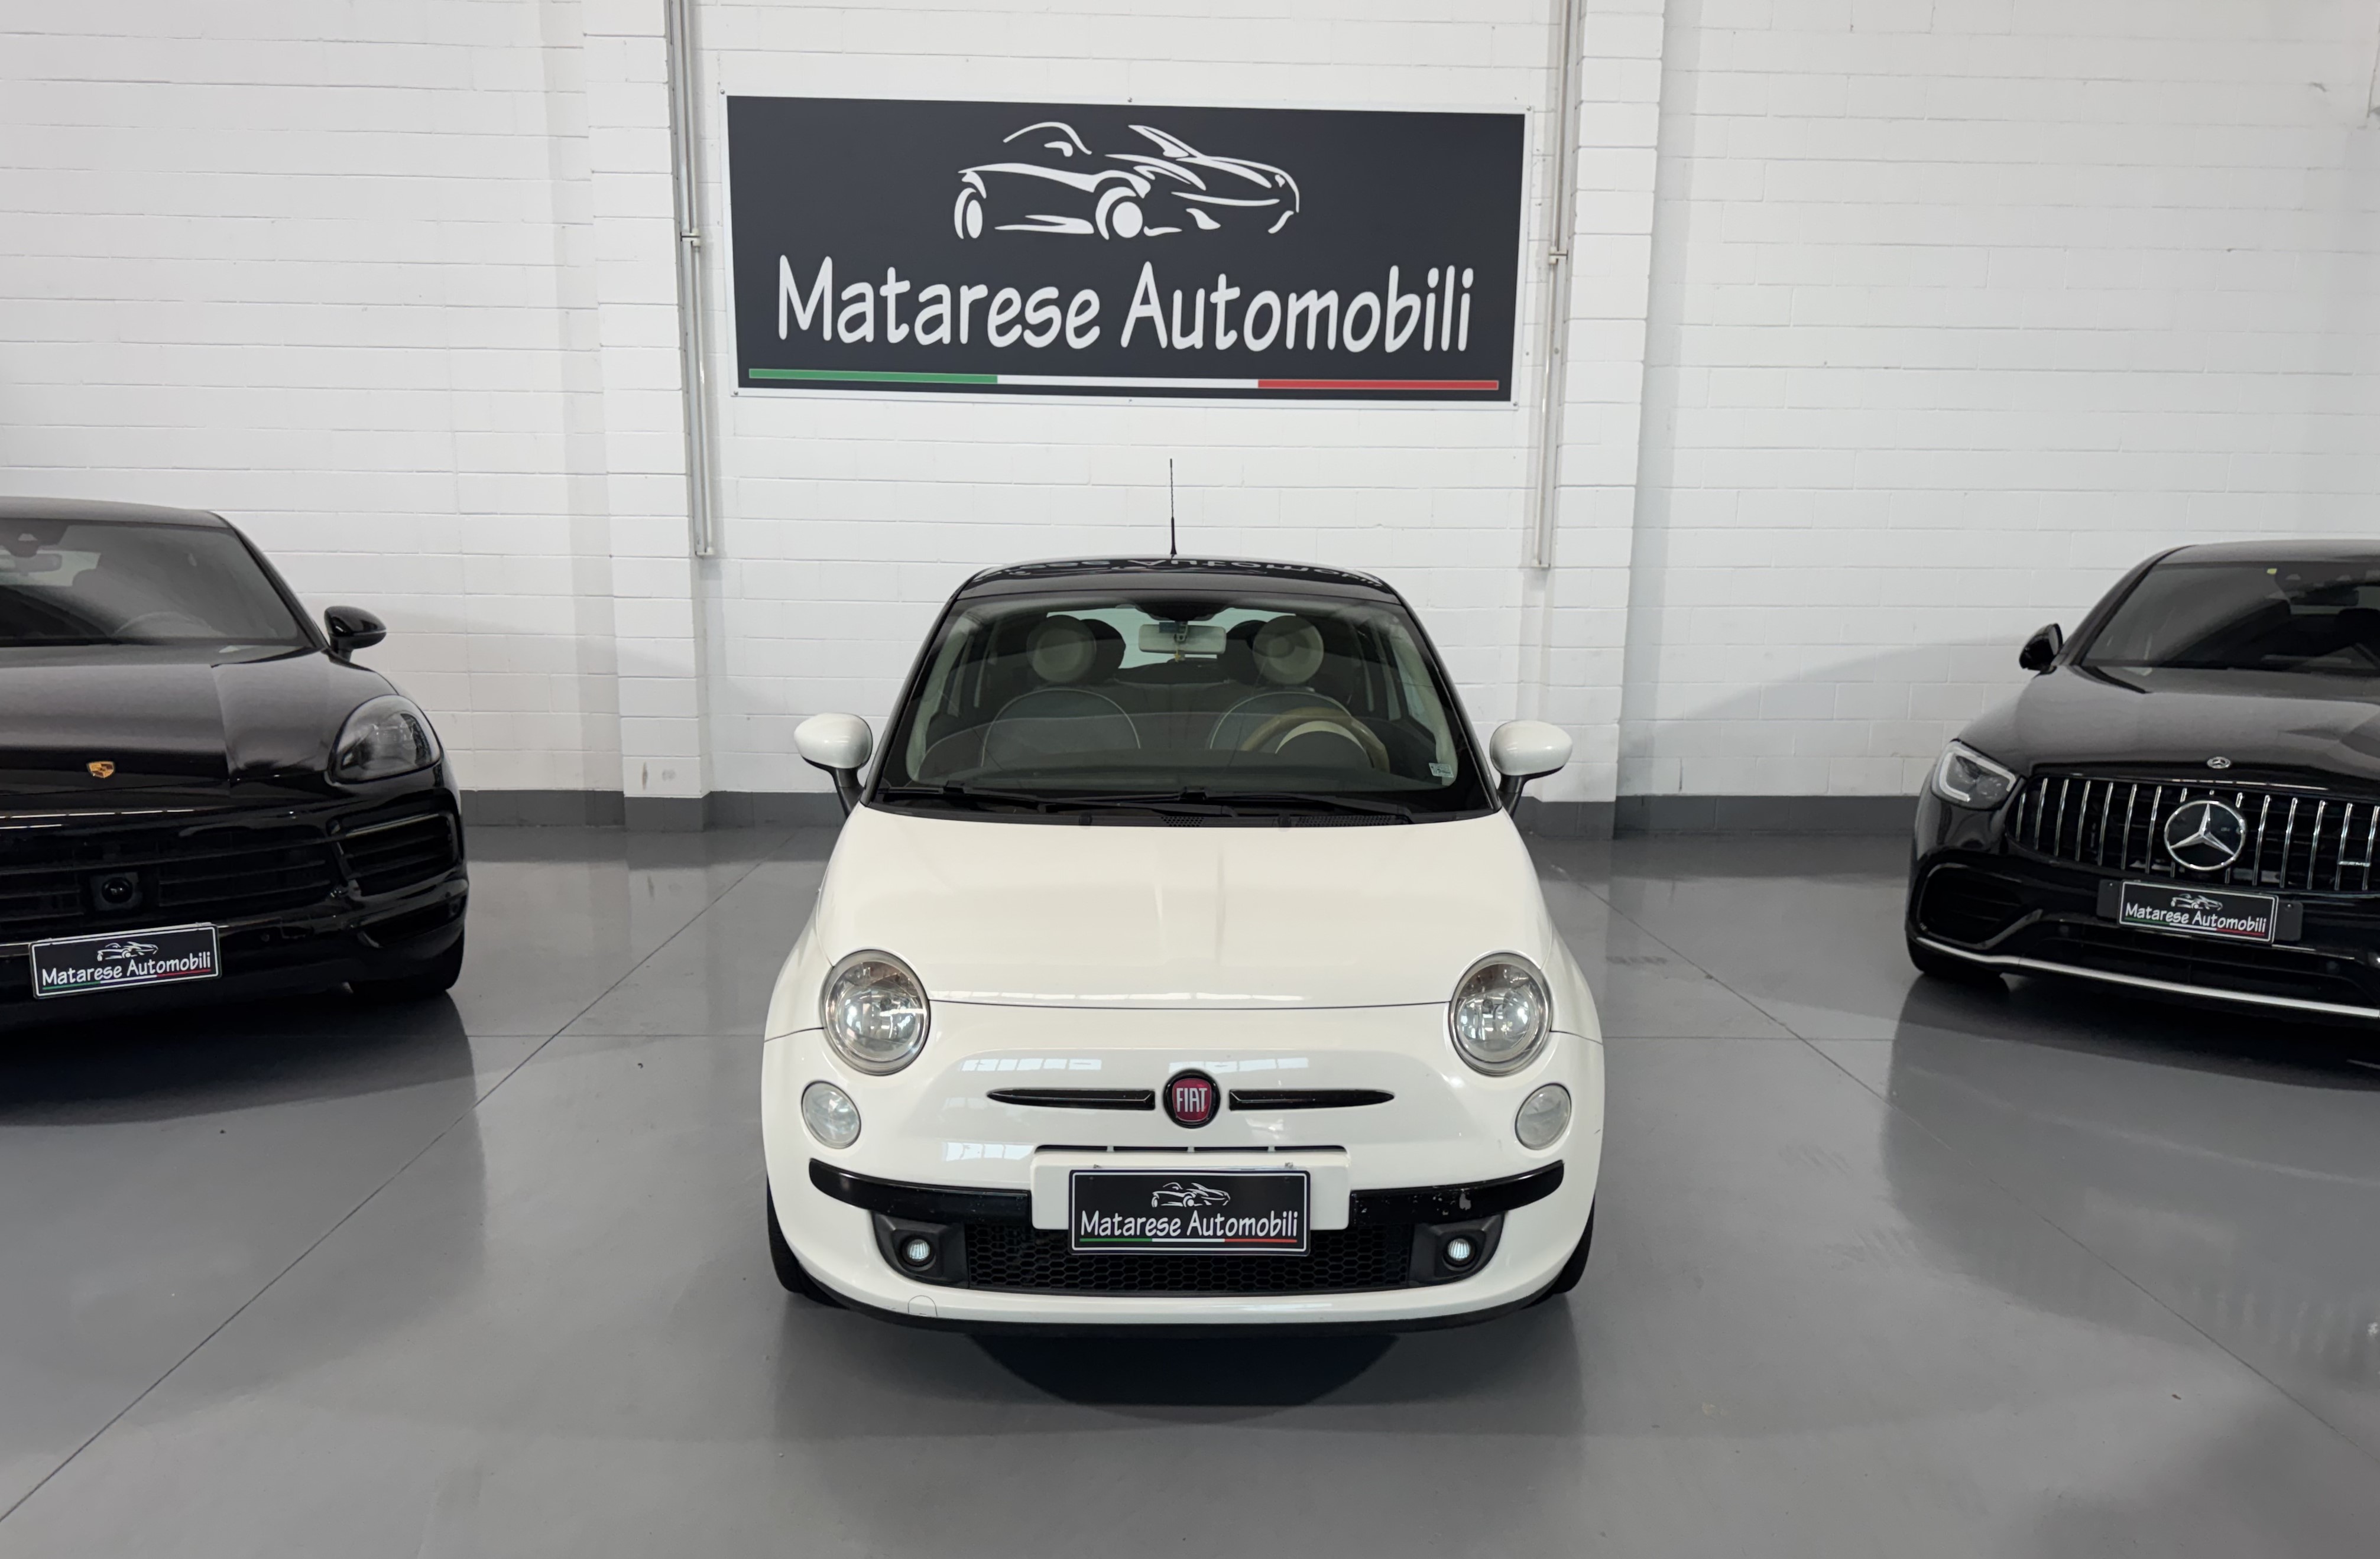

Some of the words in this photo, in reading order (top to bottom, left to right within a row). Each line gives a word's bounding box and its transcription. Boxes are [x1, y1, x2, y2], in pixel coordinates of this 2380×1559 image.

[779, 255, 1100, 349] Matarese
[1121, 261, 1474, 353] Automobili
[2125, 902, 2189, 925] Matarese
[2192, 911, 2267, 934] Automobili
[43, 966, 122, 986] Matarese
[127, 951, 210, 977] Automobili
[1176, 1087, 1208, 1113] FIAT
[1081, 1210, 1181, 1236] Matarese
[1187, 1210, 1298, 1237] Automobili
